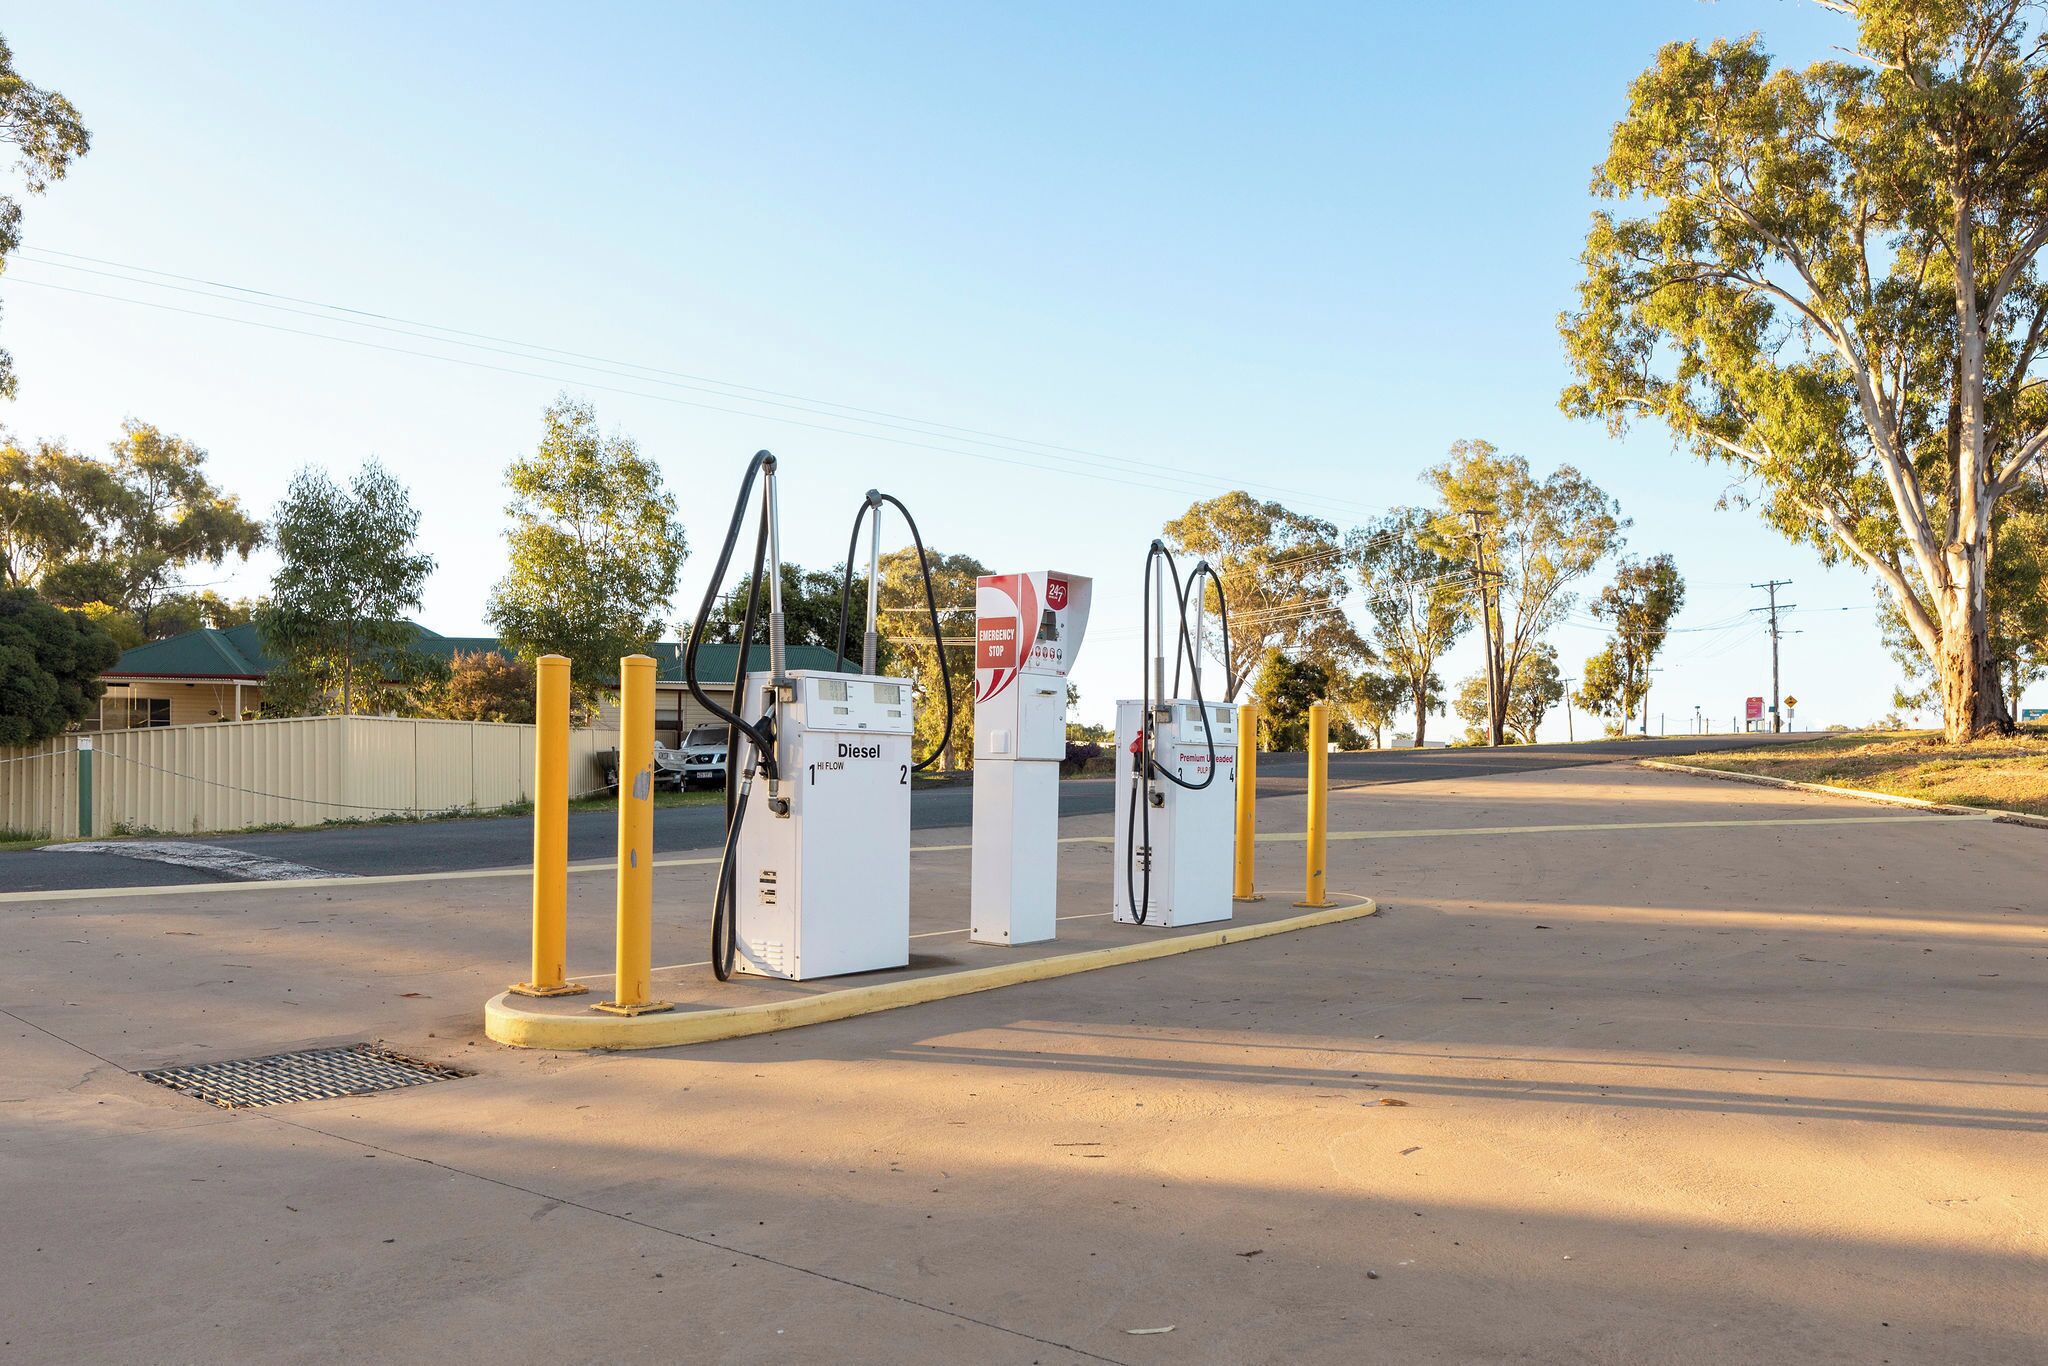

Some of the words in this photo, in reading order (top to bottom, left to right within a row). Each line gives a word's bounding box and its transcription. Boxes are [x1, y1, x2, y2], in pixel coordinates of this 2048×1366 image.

[980, 629, 1014, 641] EMERGENCY
[989, 645, 1004, 657] STOP
[838, 744, 880, 758] Diesel
[1180, 753, 1205, 762] Premium
[1207, 754, 1233, 763] Ueaded
[817, 762, 824, 770] HI
[825, 762, 844, 770] FLOW
[809, 764, 815, 785] 1
[900, 765, 907, 784] 2
[1178, 768, 1182, 781] 3
[1230, 768, 1234, 782] 4
